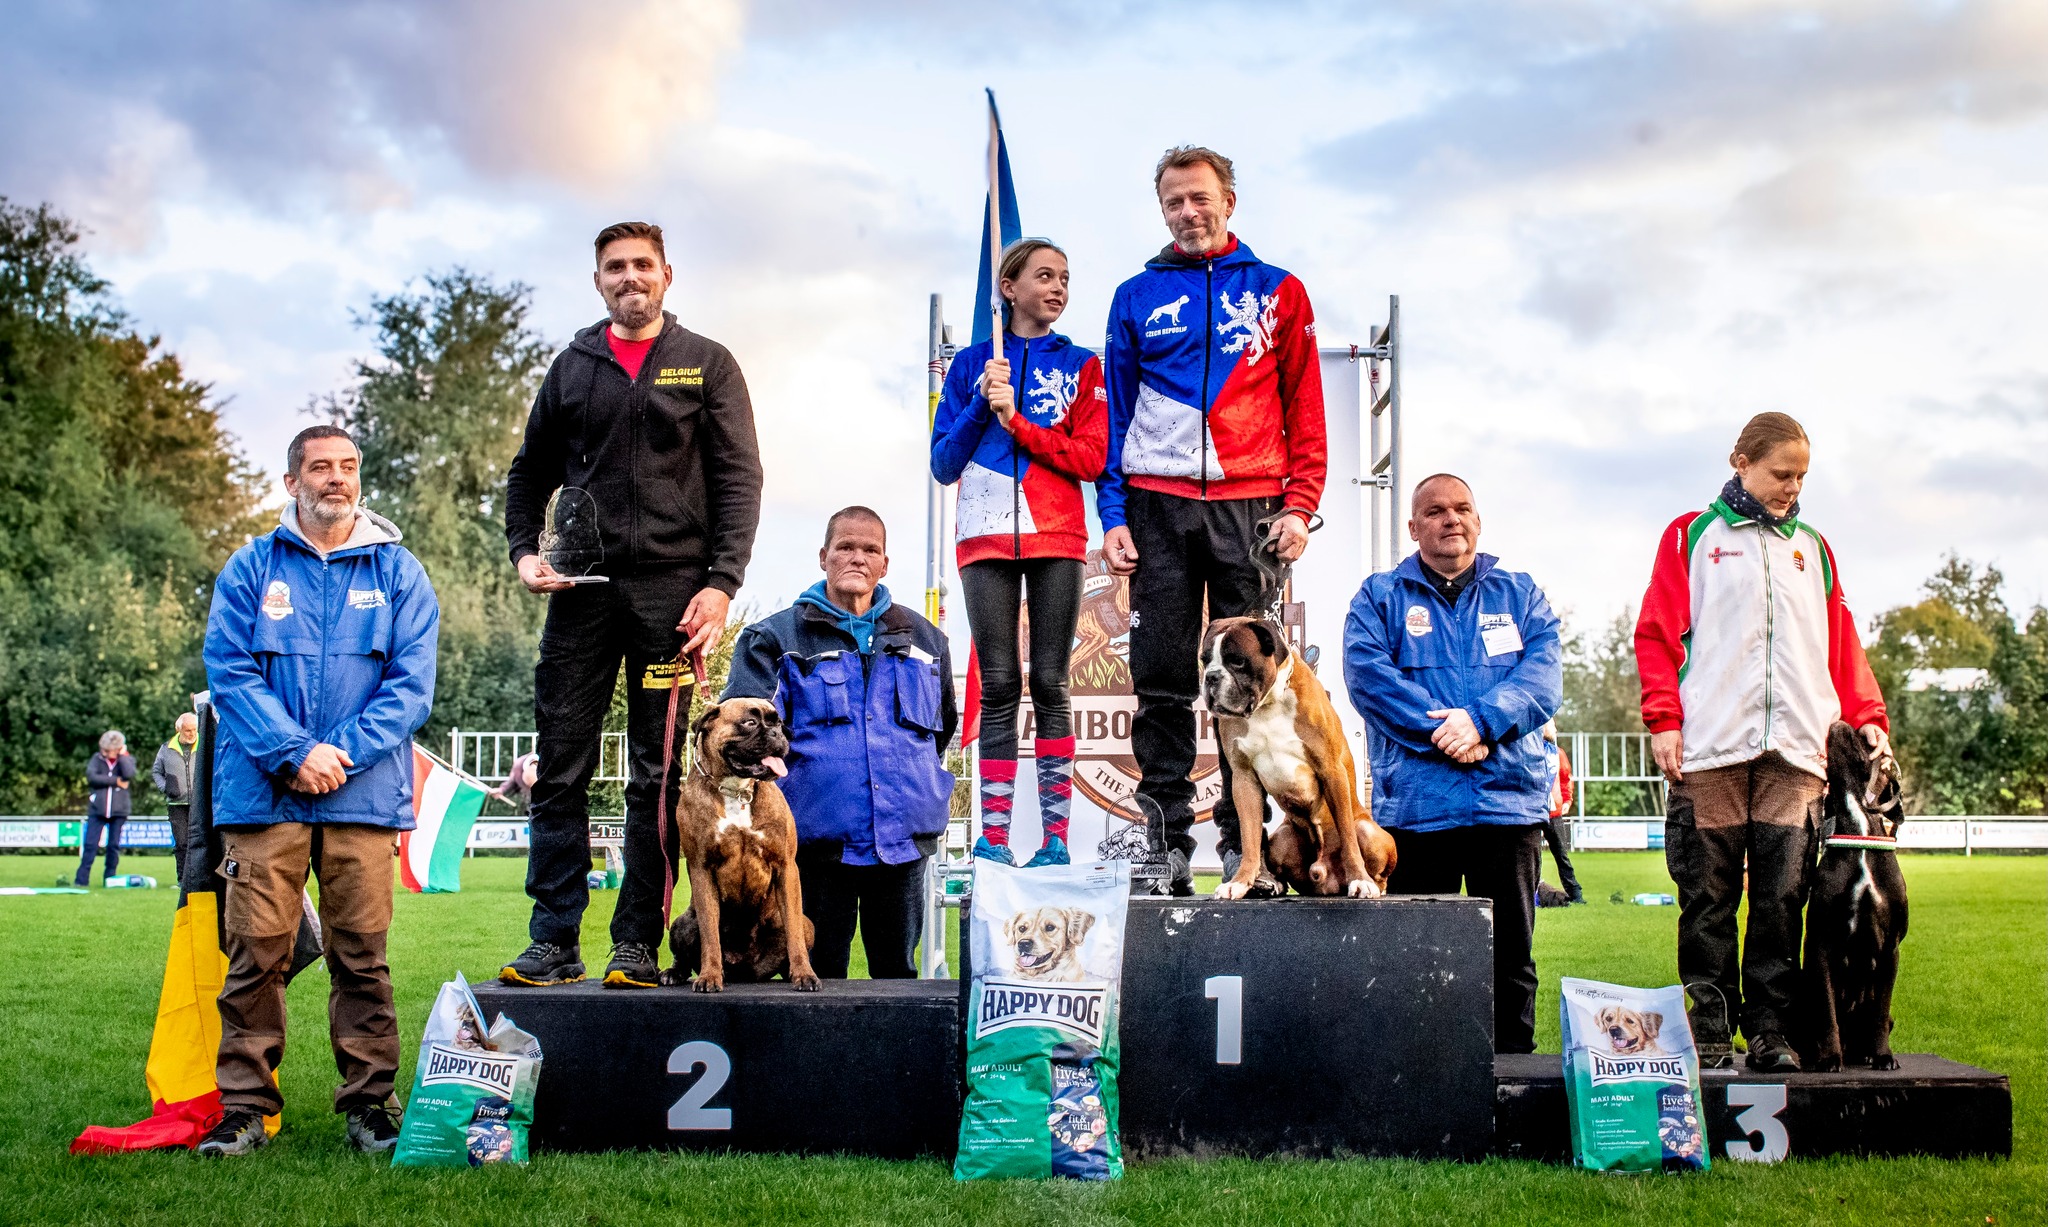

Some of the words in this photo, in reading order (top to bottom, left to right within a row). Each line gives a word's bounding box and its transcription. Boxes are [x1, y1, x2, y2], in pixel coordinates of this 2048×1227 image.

[660, 367, 701, 376] BELGIUM
[1095, 766, 1125, 795] THE
[487, 831, 505, 839] BPZ
[1577, 826, 1602, 838] FTC
[982, 989, 1054, 1023] HAPPY
[1056, 994, 1102, 1030] DOG
[1205, 976, 1242, 1064] 1
[428, 1052, 479, 1076] HAPPY
[478, 1061, 513, 1088] DOG
[991, 1063, 1022, 1072] ADULT
[1055, 1064, 1079, 1079] five
[1594, 1056, 1646, 1076] HAPPY
[1649, 1061, 1683, 1076] DOG
[667, 1040, 732, 1130] 2
[431, 1098, 453, 1107] ADULT
[1591, 1095, 1610, 1104] MAXI
[1611, 1094, 1635, 1102] ADULT
[1662, 1094, 1684, 1106] five
[478, 1104, 498, 1117] five
[1072, 1121, 1091, 1131] vital
[1726, 1084, 1788, 1163] 3
[1676, 1134, 1691, 1142] vital
